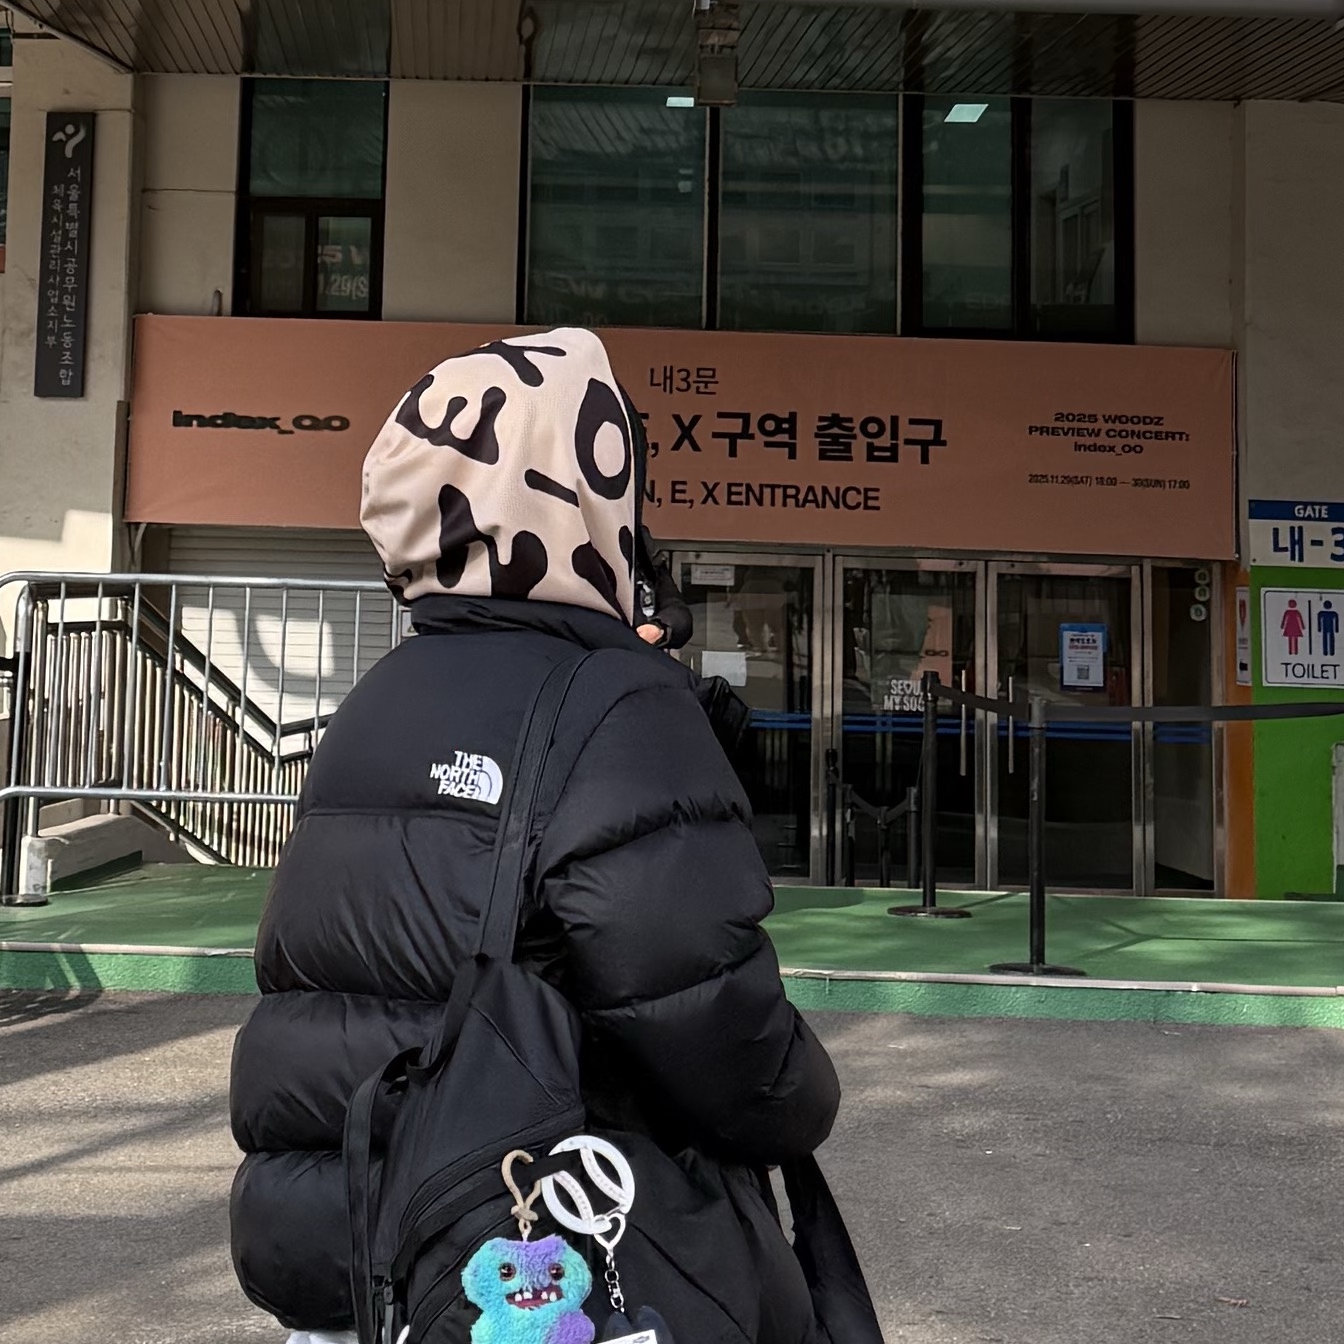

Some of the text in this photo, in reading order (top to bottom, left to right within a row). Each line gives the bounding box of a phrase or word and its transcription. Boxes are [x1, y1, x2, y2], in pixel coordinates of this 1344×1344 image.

[649, 365, 719, 395] 내3문
[1054, 412, 1164, 426] 2025 WOODZ
[670, 414, 702, 452] X
[711, 411, 797, 460] 구역
[814, 413, 947, 465] 출입구
[1028, 425, 1190, 441] PREVIEW CONCERT:
[670, 480, 694, 509] E,
[700, 481, 720, 505] X
[726, 482, 881, 511] ENTRANCE
[1294, 505, 1329, 519] GATE
[1281, 662, 1340, 680] TOILET
[454, 750, 483, 770] THE
[429, 763, 478, 785] NORTH
[438, 780, 475, 798] FACE
